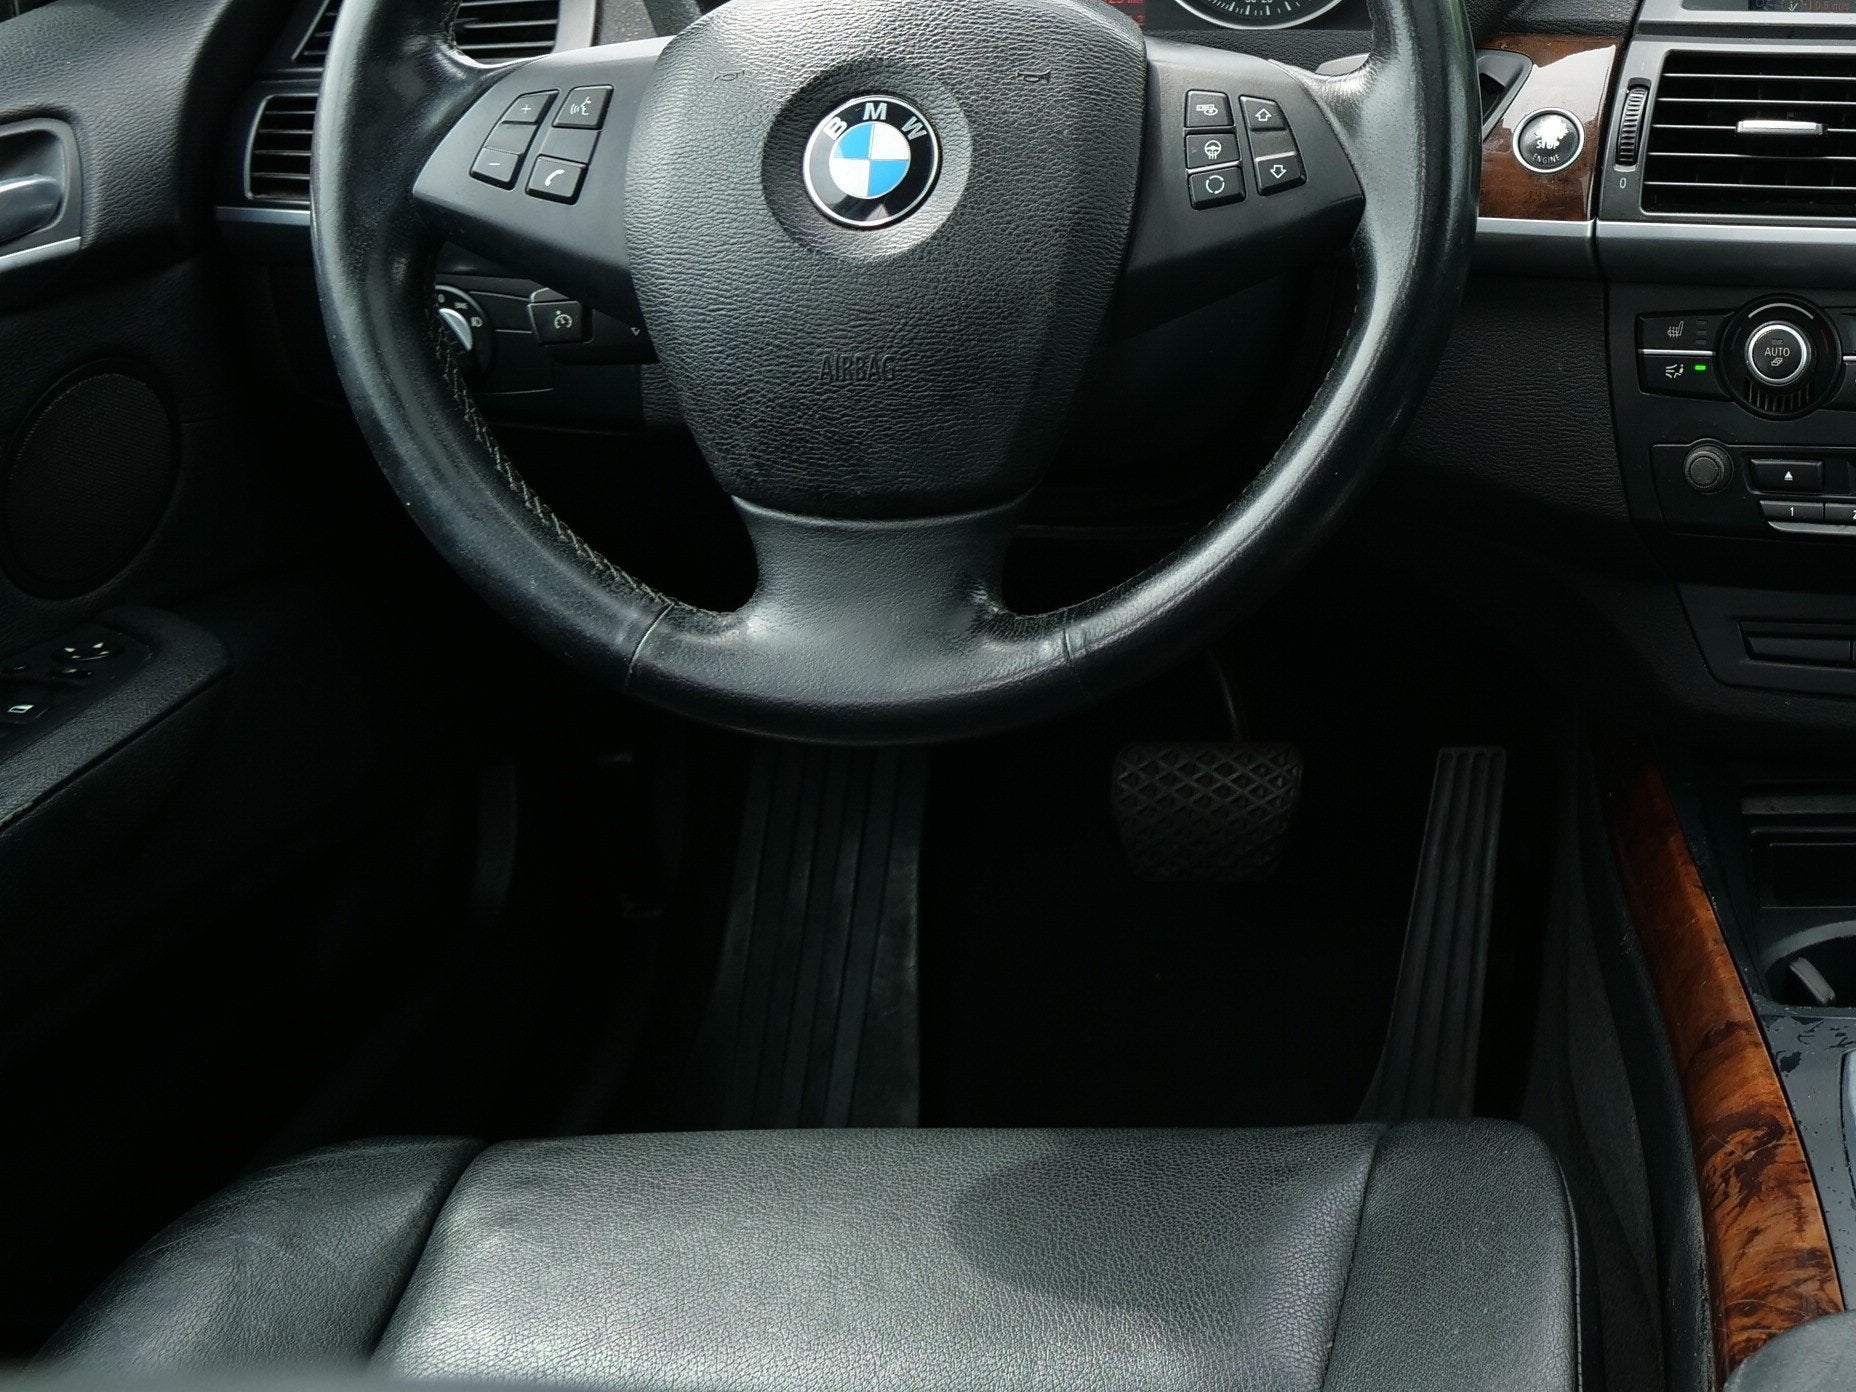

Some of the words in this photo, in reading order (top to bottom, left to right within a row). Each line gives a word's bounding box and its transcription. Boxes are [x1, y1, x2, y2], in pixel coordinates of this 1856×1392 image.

[822, 102, 927, 140] BMW
[1533, 153, 1561, 165] ENGINE
[1764, 347, 1790, 357] AUTO
[818, 354, 897, 382] AIRBAG
